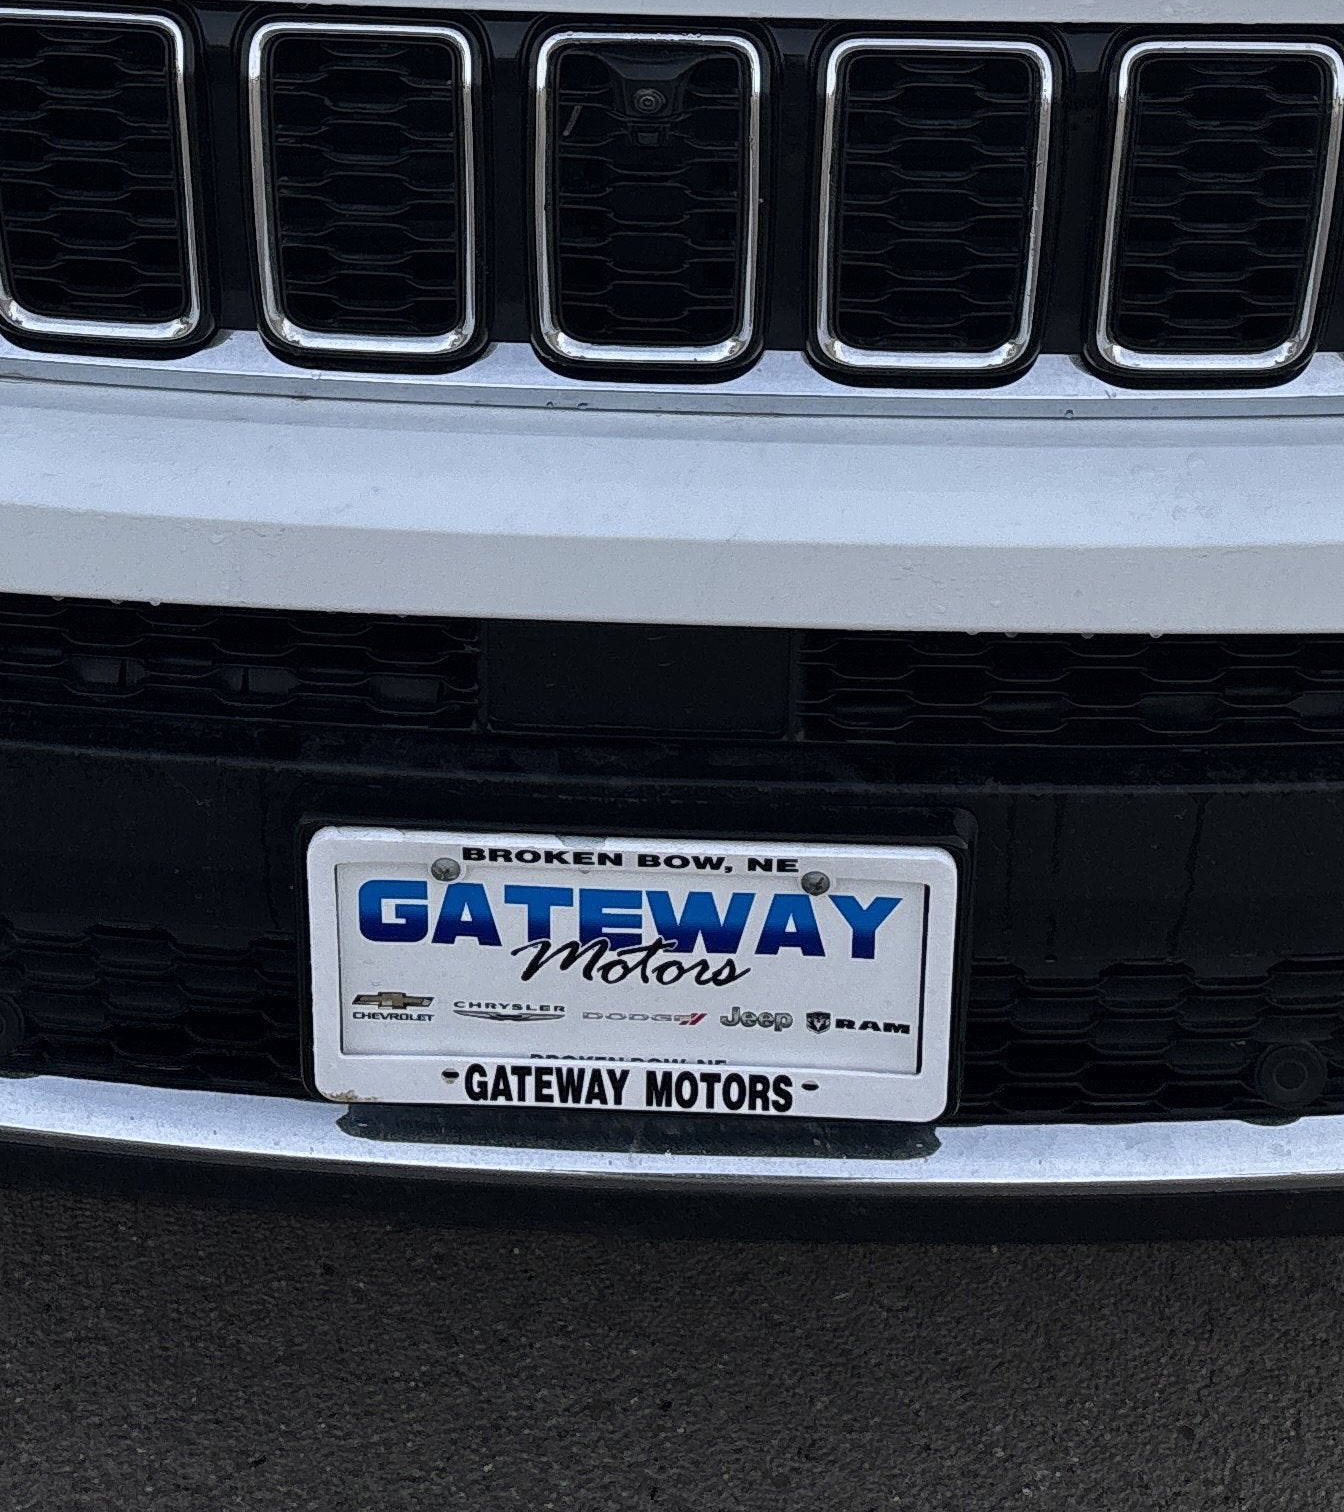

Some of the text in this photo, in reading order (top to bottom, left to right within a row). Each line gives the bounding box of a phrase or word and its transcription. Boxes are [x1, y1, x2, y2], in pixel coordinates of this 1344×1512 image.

[462, 847, 799, 874] BROKEN BOW, NE
[358, 879, 903, 959] GATEWAY
[511, 937, 752, 987] Motors
[352, 1011, 434, 1022] CHEVROLET
[453, 1001, 565, 1013] CHRYSLER
[582, 1011, 691, 1022] DODGE
[720, 1007, 794, 1032] Jeep
[835, 1018, 911, 1034] RAM
[464, 1063, 793, 1113] GATEWAY MOTORS
